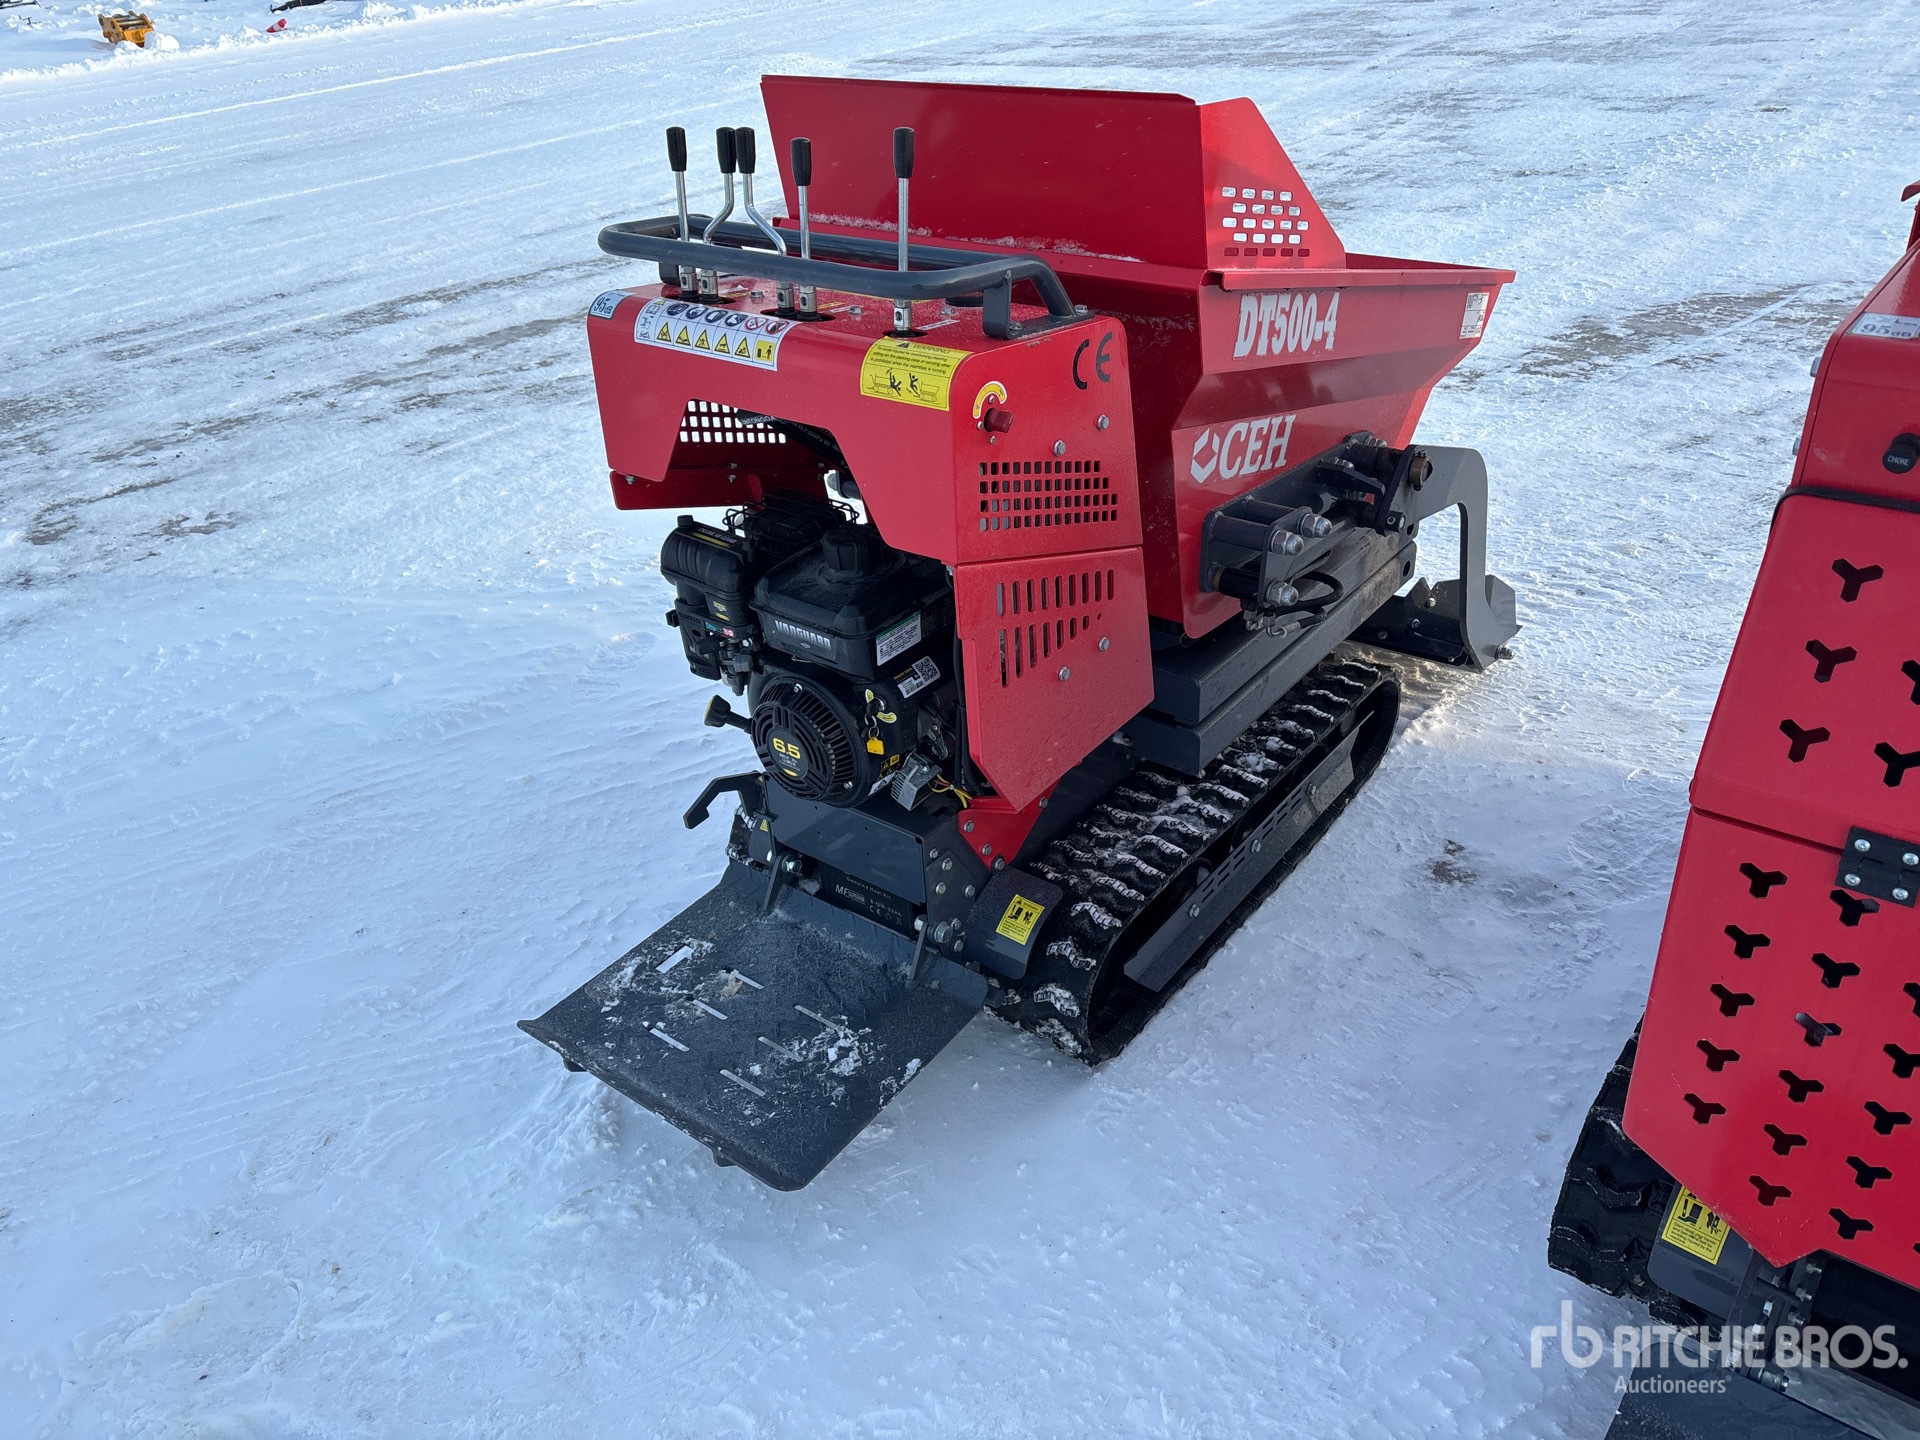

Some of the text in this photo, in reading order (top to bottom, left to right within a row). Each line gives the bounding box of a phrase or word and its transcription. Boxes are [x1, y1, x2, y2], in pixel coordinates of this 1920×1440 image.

[594, 297, 606, 312] 95
[1233, 292, 1340, 360] DT500-4
[1861, 323, 1891, 335] 95
[1073, 331, 1112, 390] CE
[1219, 414, 1297, 479] CEH
[1887, 455, 1911, 466] CHOKE
[775, 620, 831, 650] VANGUARD
[773, 737, 801, 760] 6.5
